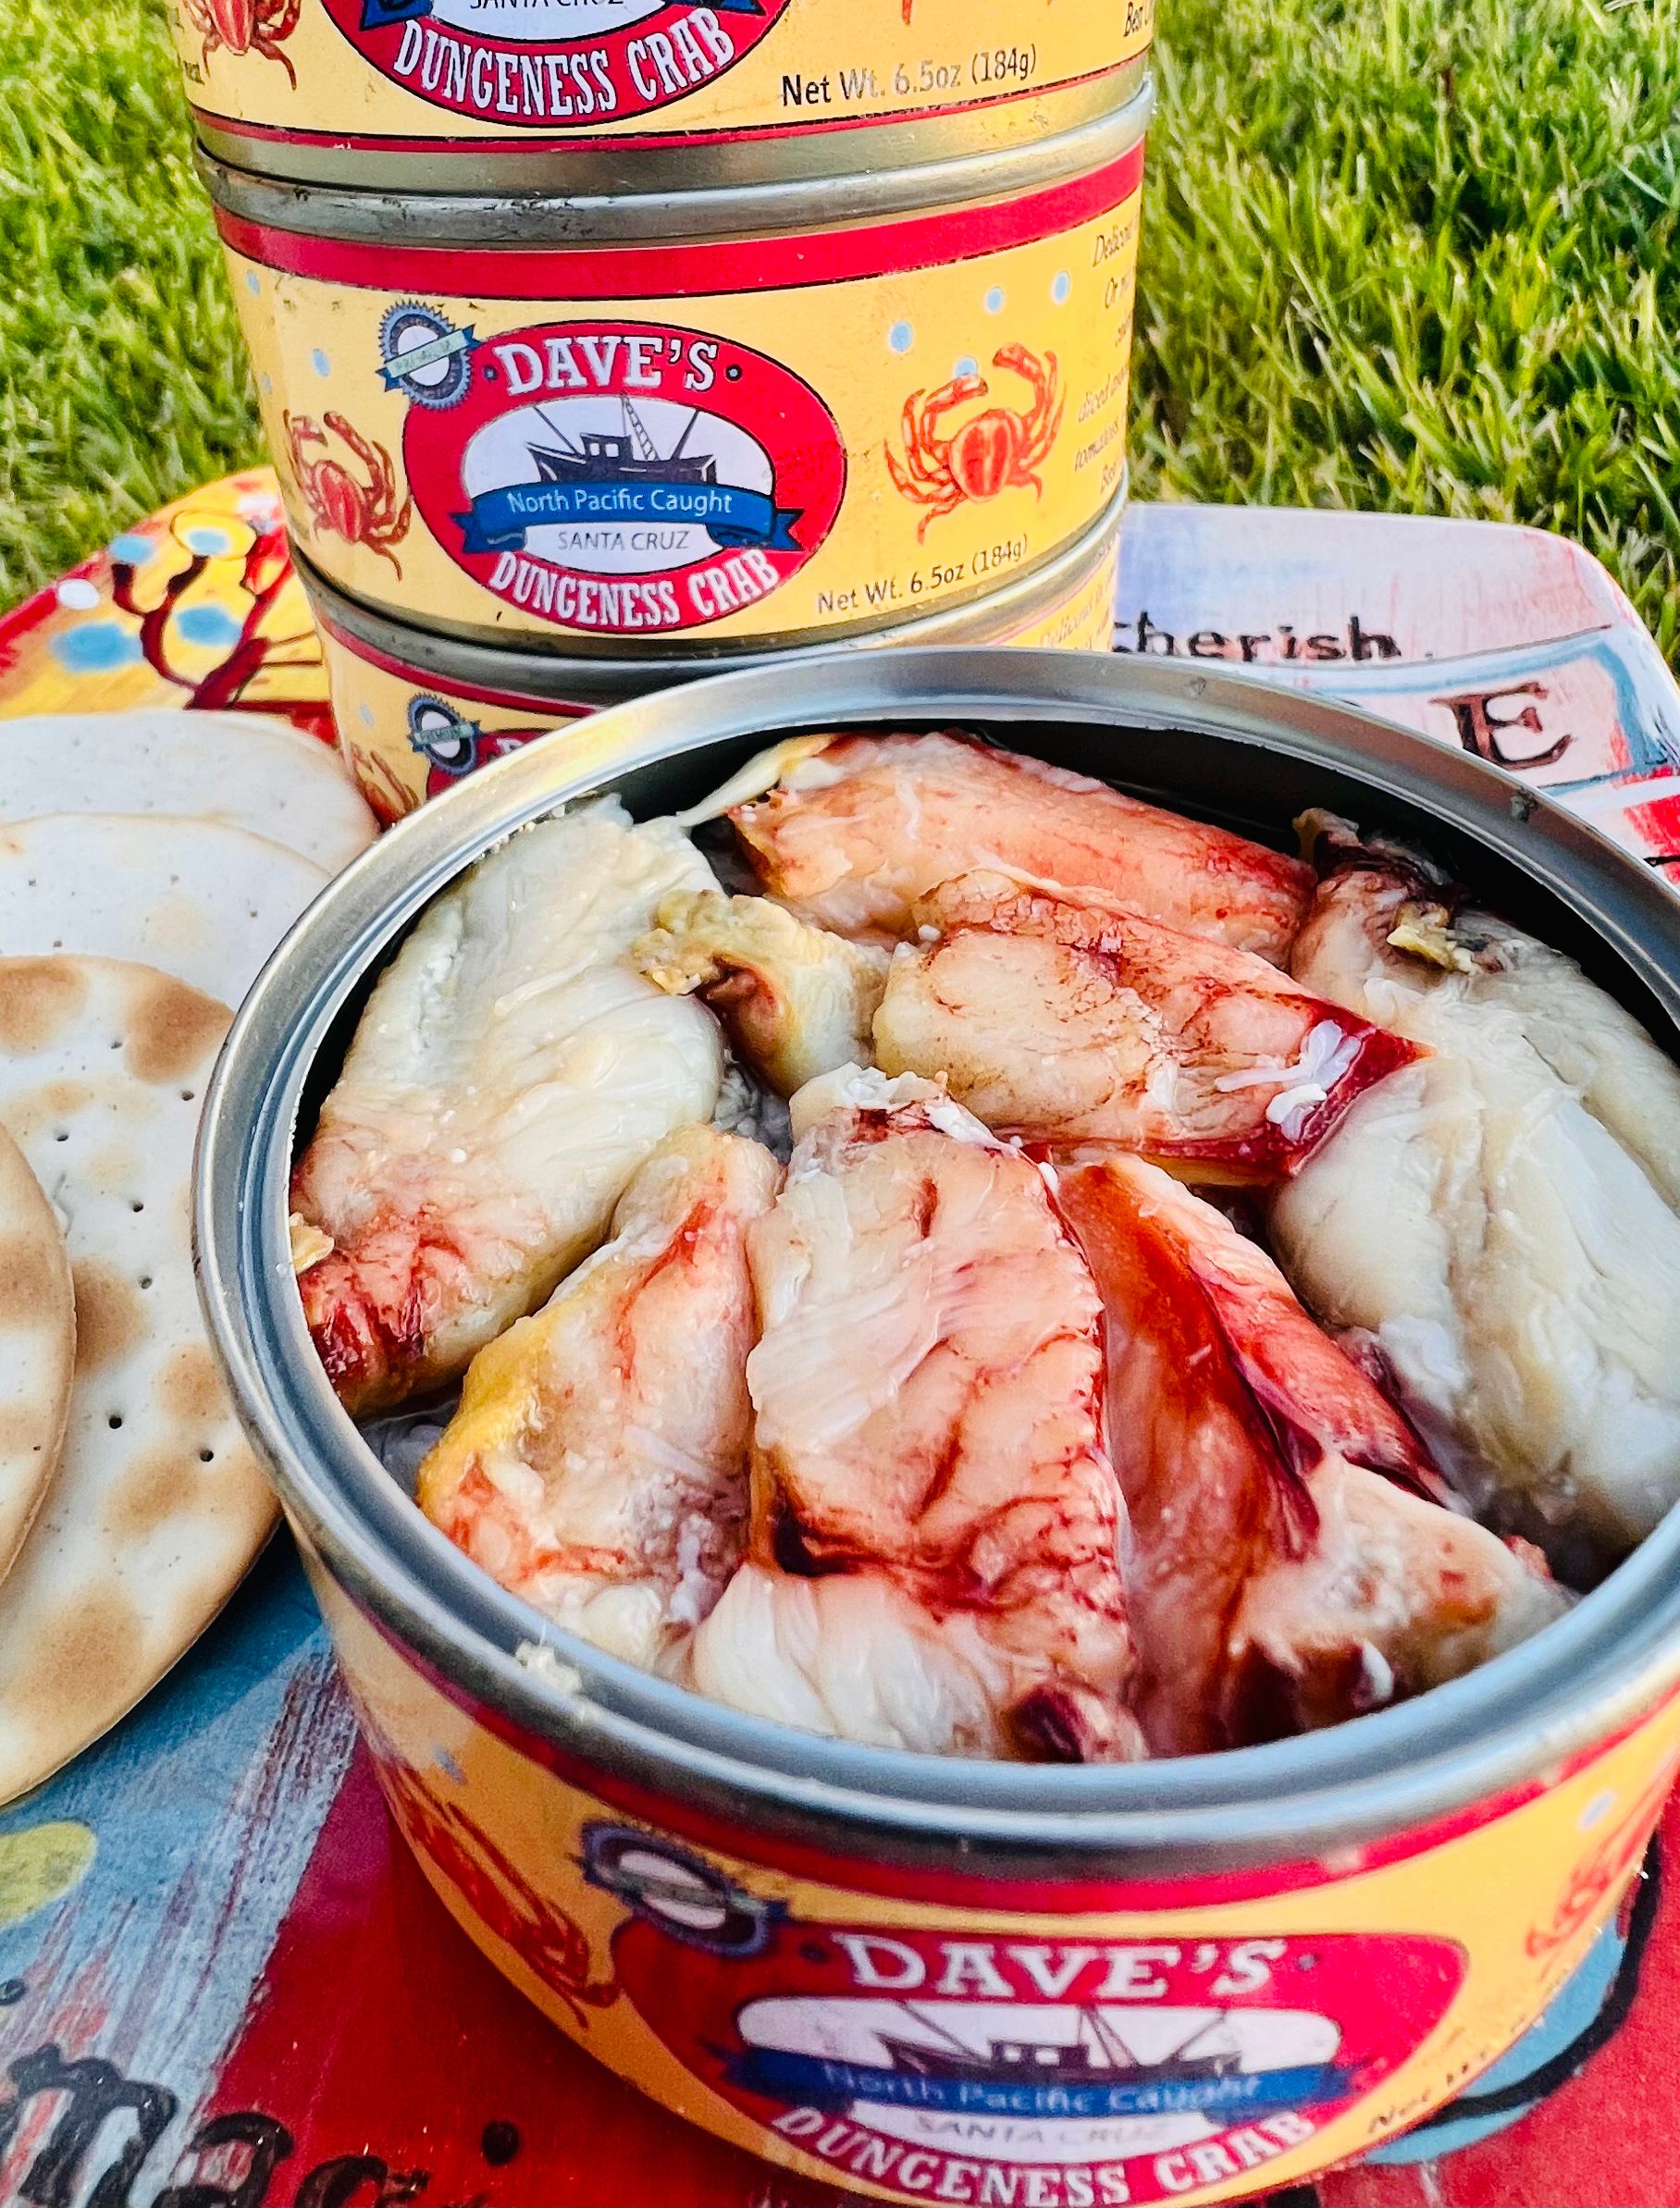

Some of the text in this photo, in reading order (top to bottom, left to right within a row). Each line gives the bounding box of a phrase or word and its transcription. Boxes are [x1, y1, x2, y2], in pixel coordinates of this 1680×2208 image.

[394, 7, 735, 116] DUNGENESS CRAB
[781, 43, 1037, 106] Net Wt. 6.5oz (184g)
[494, 335, 719, 395] DAVE'S
[507, 487, 733, 517] North Pacific Caught
[558, 531, 689, 550] SANTA CRUZ
[818, 533, 1028, 614] Net Wt. 6.5oz (184g)
[489, 548, 780, 627] DUNGENESS CRAB
[830, 1933, 1287, 2000] DAVE'S
[772, 2105, 1316, 2208] DUNGENESS CRAB
